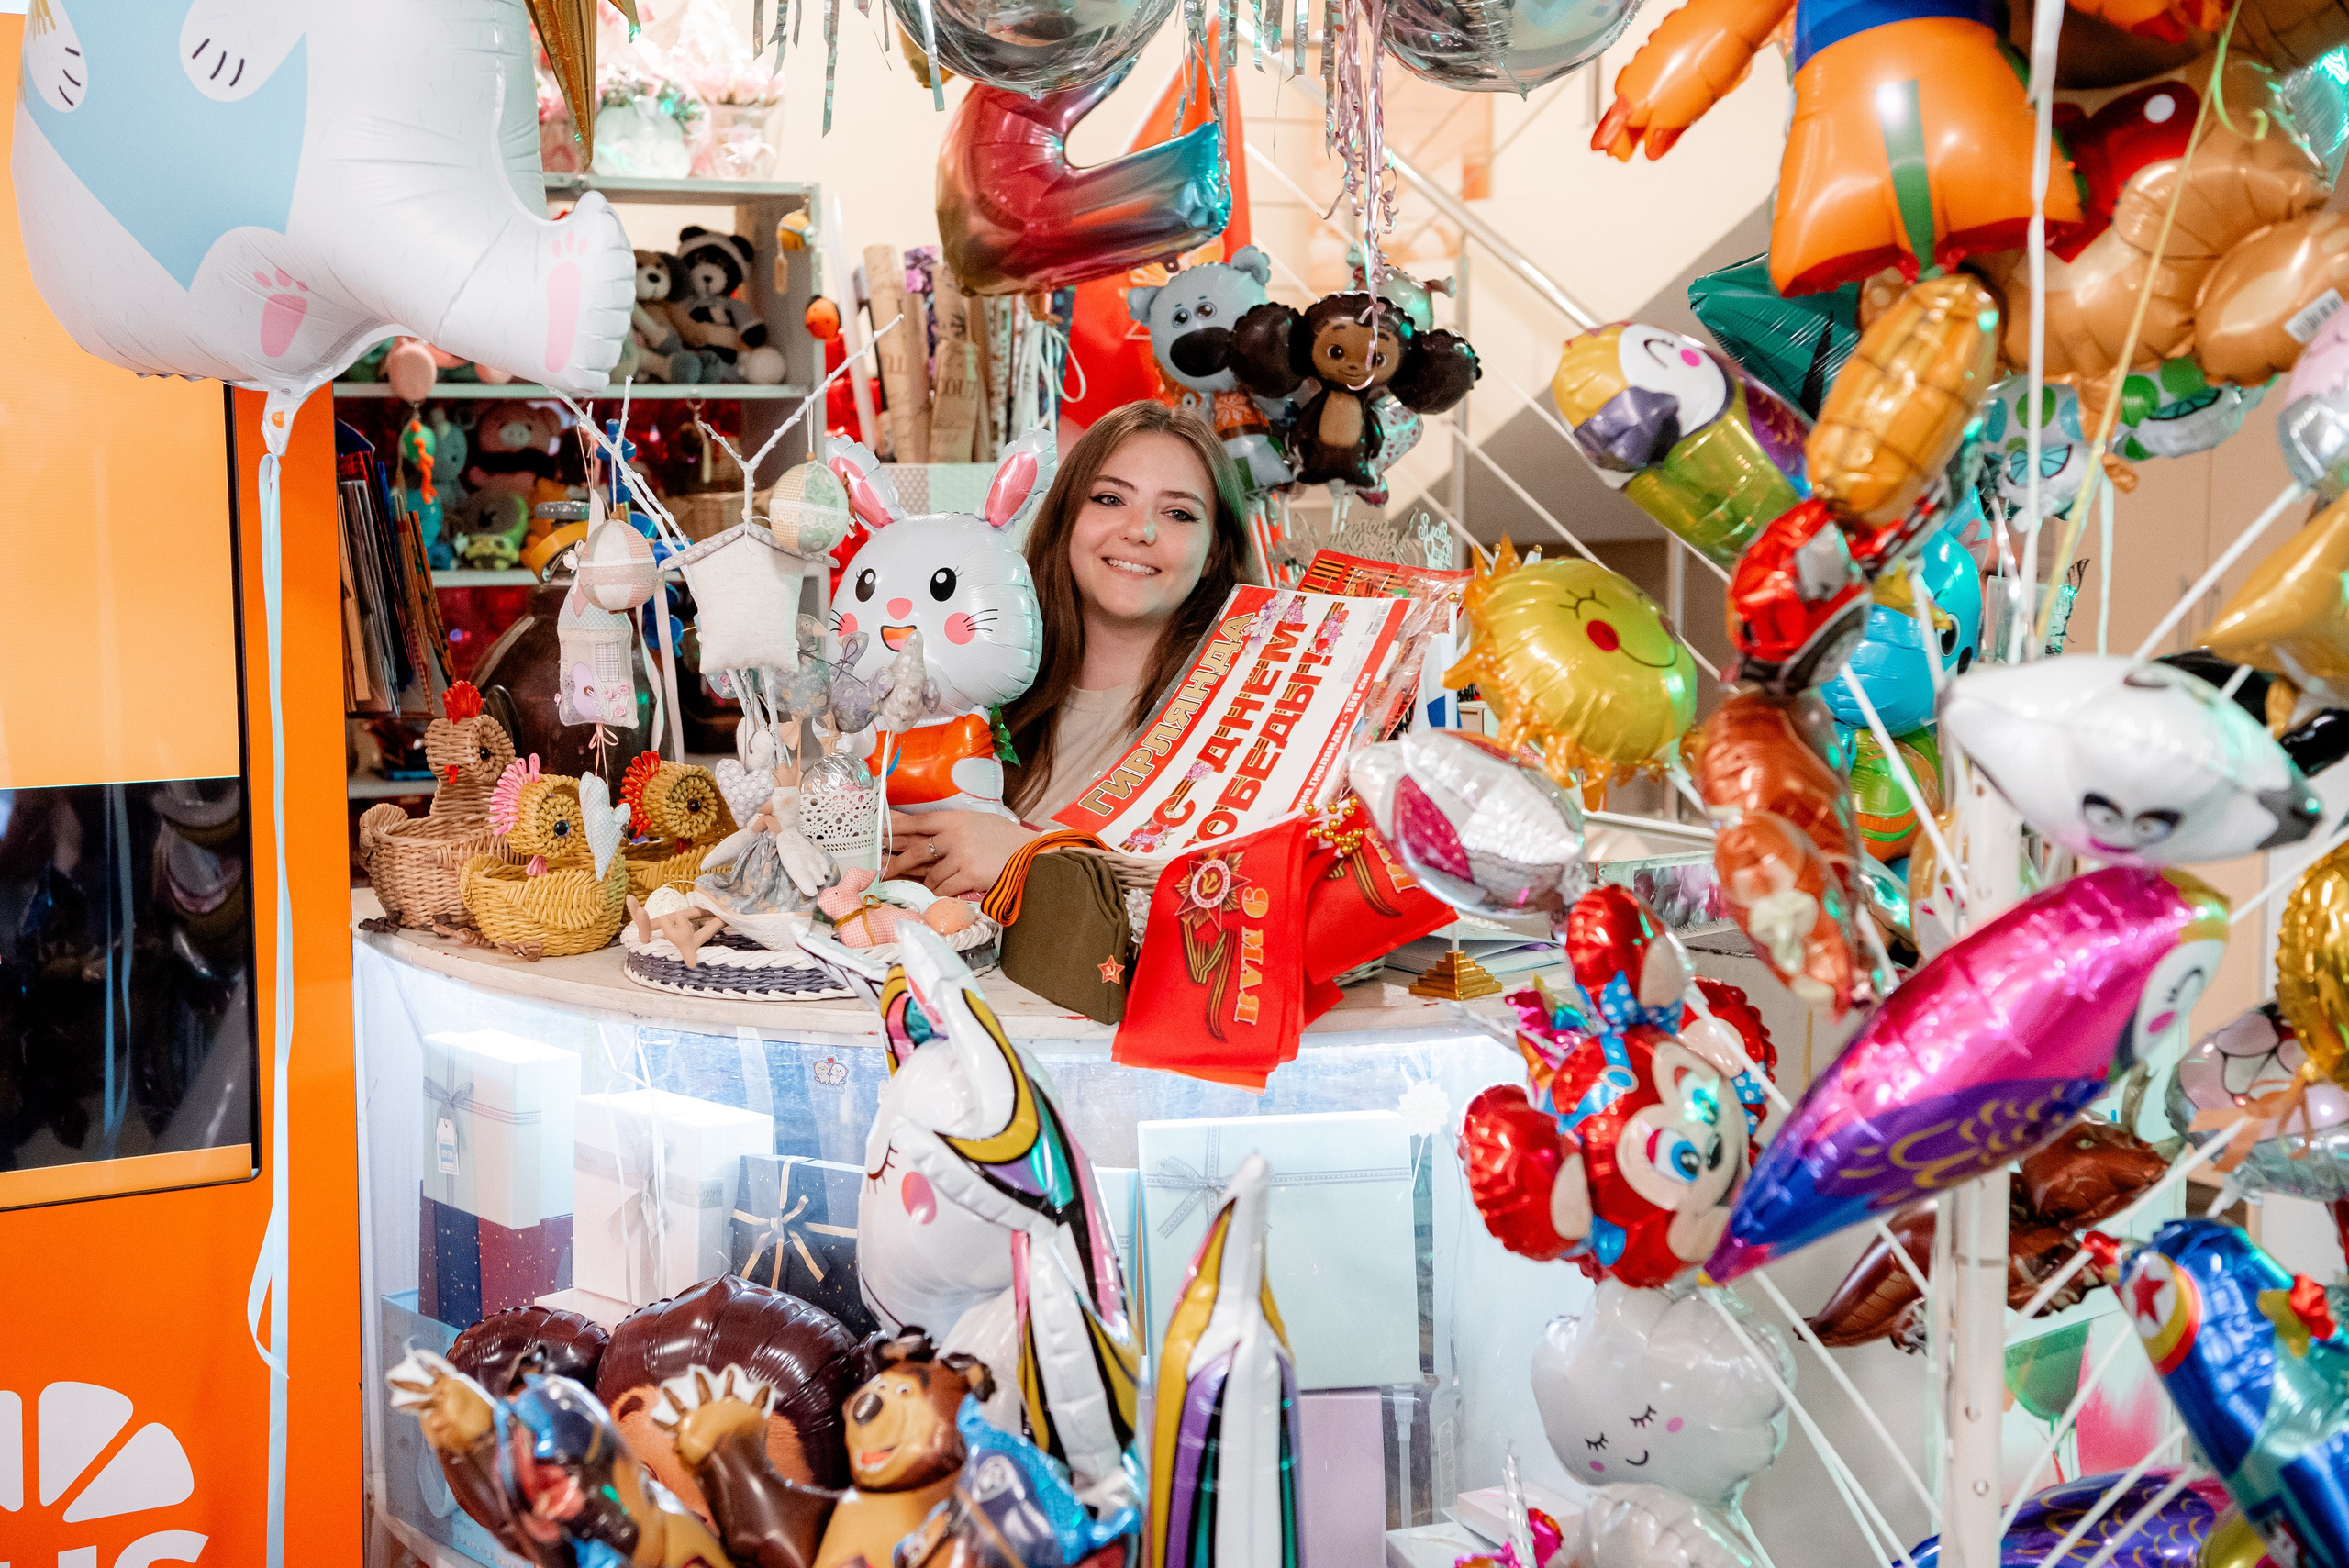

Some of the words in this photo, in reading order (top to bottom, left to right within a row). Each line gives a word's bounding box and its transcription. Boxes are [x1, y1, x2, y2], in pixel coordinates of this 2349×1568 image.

[1078, 613, 1255, 816] ГИРЛЯНДА
[1180, 651, 1333, 850] ОБЕДЫ!
[1308, 722, 1348, 787] гирлянды
[1344, 692, 1362, 713] 180
[1357, 673, 1372, 691] см
[1152, 795, 1197, 828] С
[1241, 886, 1269, 919] 9
[1233, 925, 1264, 1026] МАЯ
